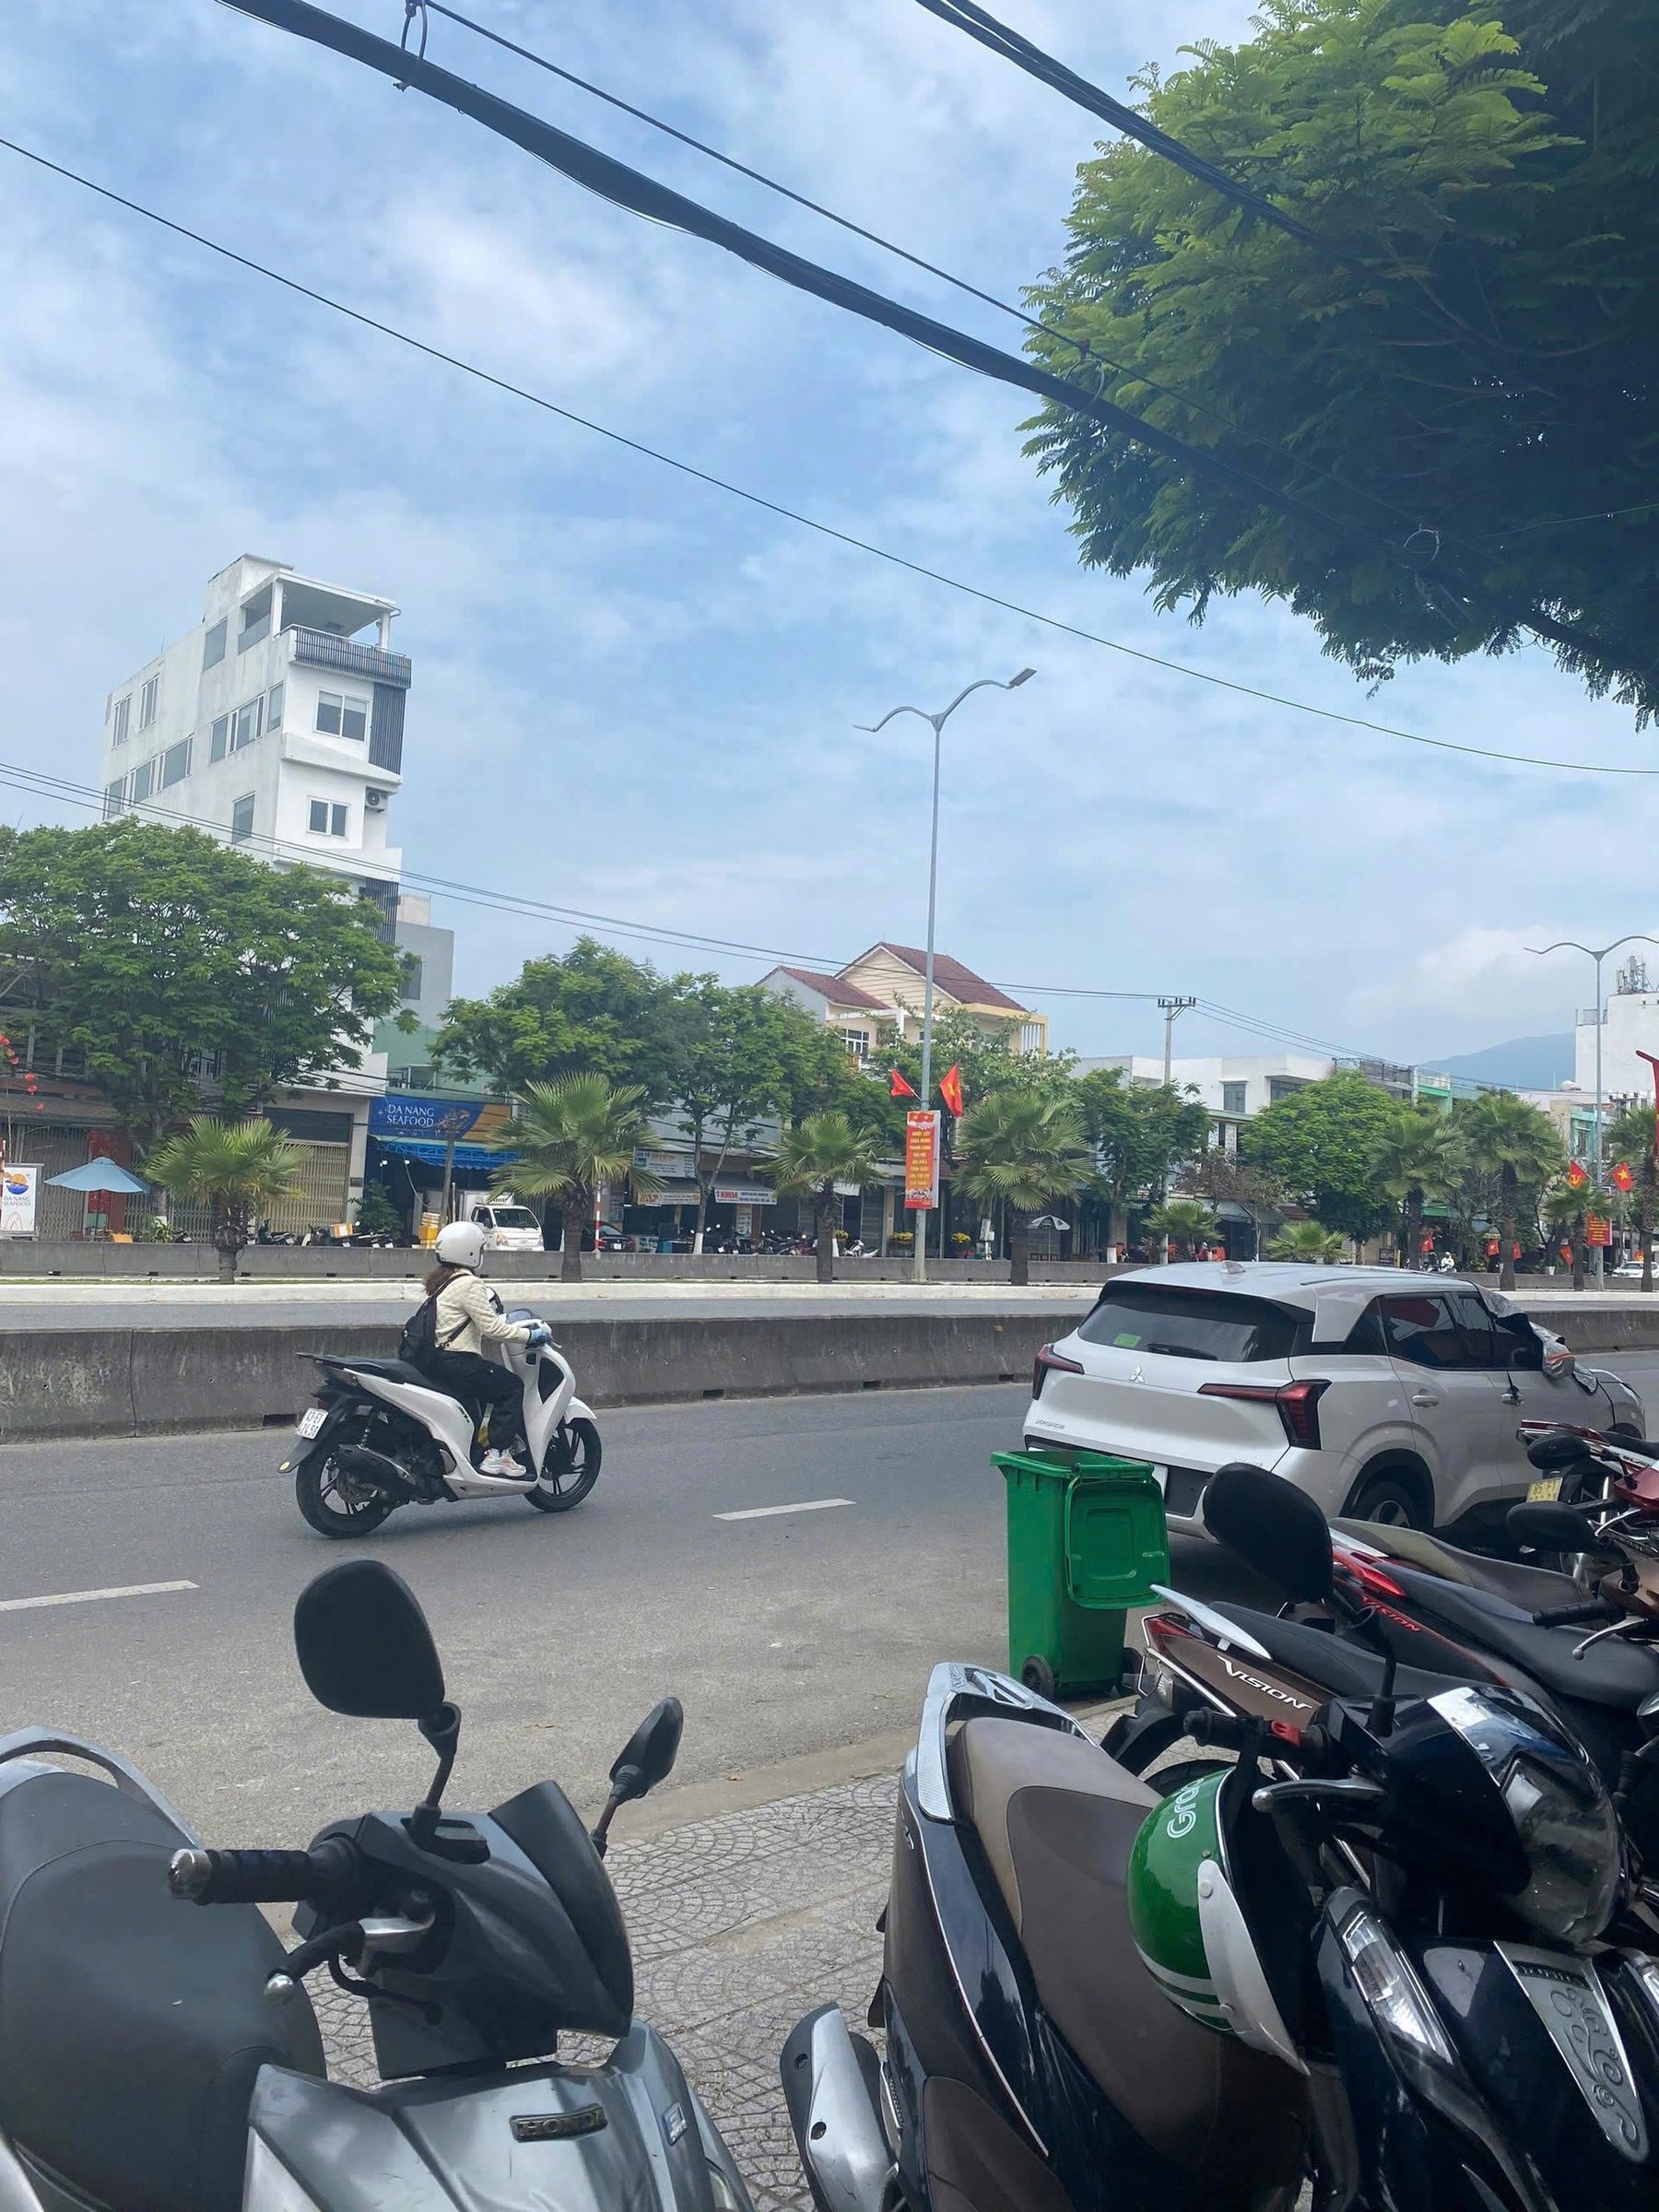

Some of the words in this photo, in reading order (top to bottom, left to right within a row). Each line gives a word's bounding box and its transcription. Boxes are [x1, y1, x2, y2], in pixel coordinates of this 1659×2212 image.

[388, 1104, 403, 1115] DA
[405, 1106, 435, 1117] NANG
[386, 1114, 434, 1127] SEAFOOD
[720, 1190, 738, 1199] KHOA
[1217, 1654, 1313, 1710] VISION
